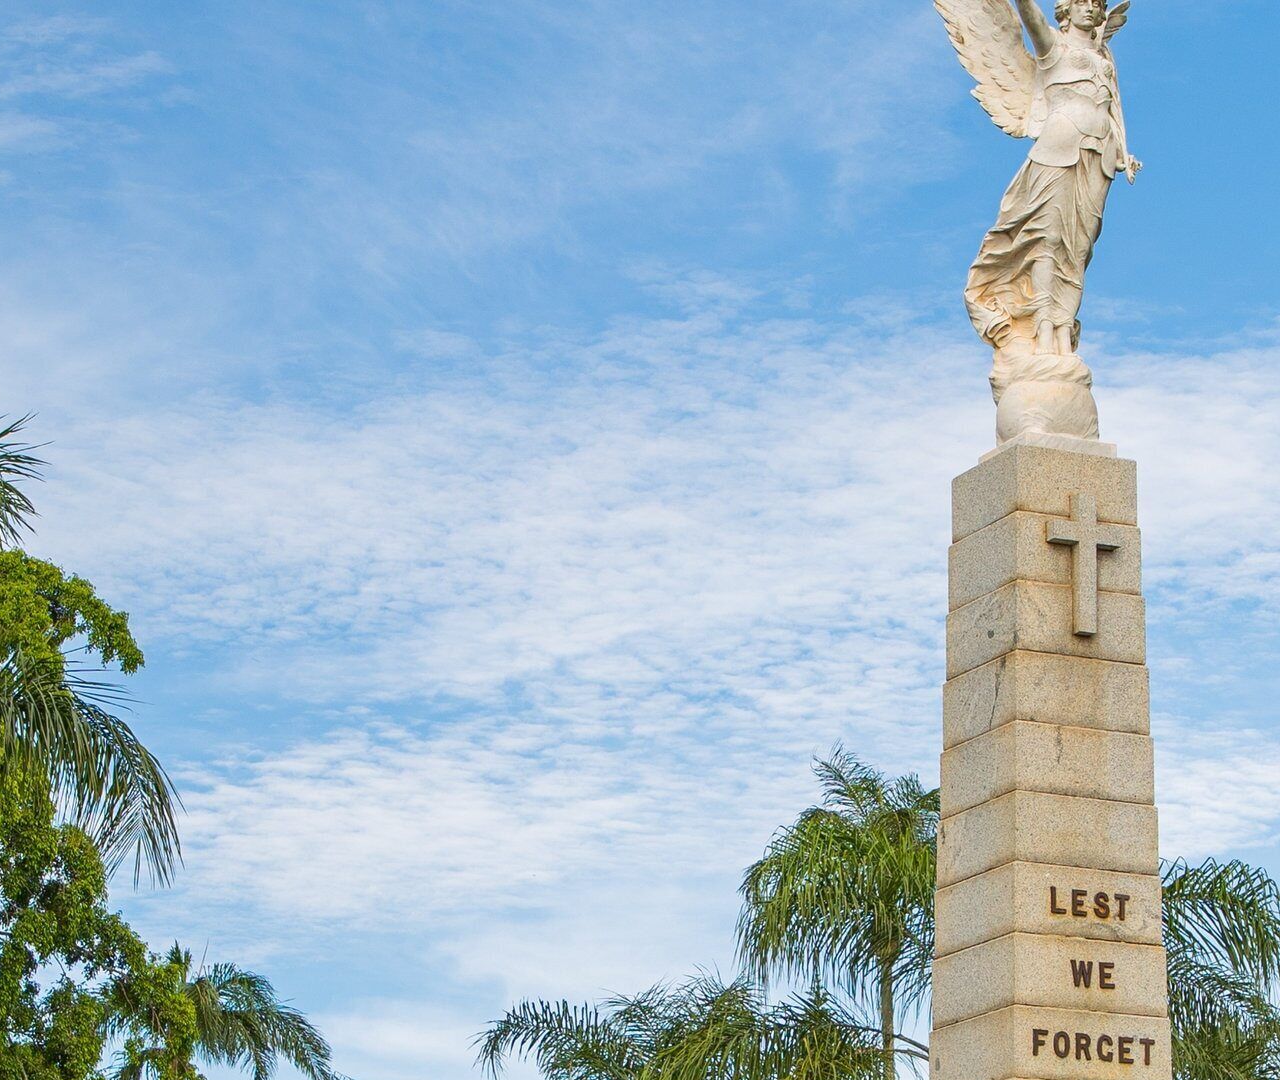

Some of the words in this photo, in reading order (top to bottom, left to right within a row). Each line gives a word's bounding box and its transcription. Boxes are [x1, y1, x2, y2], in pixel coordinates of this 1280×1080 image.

[1050, 886, 1130, 921] LEST
[1070, 959, 1116, 990] WE
[1032, 1028, 1156, 1066] FORGET
